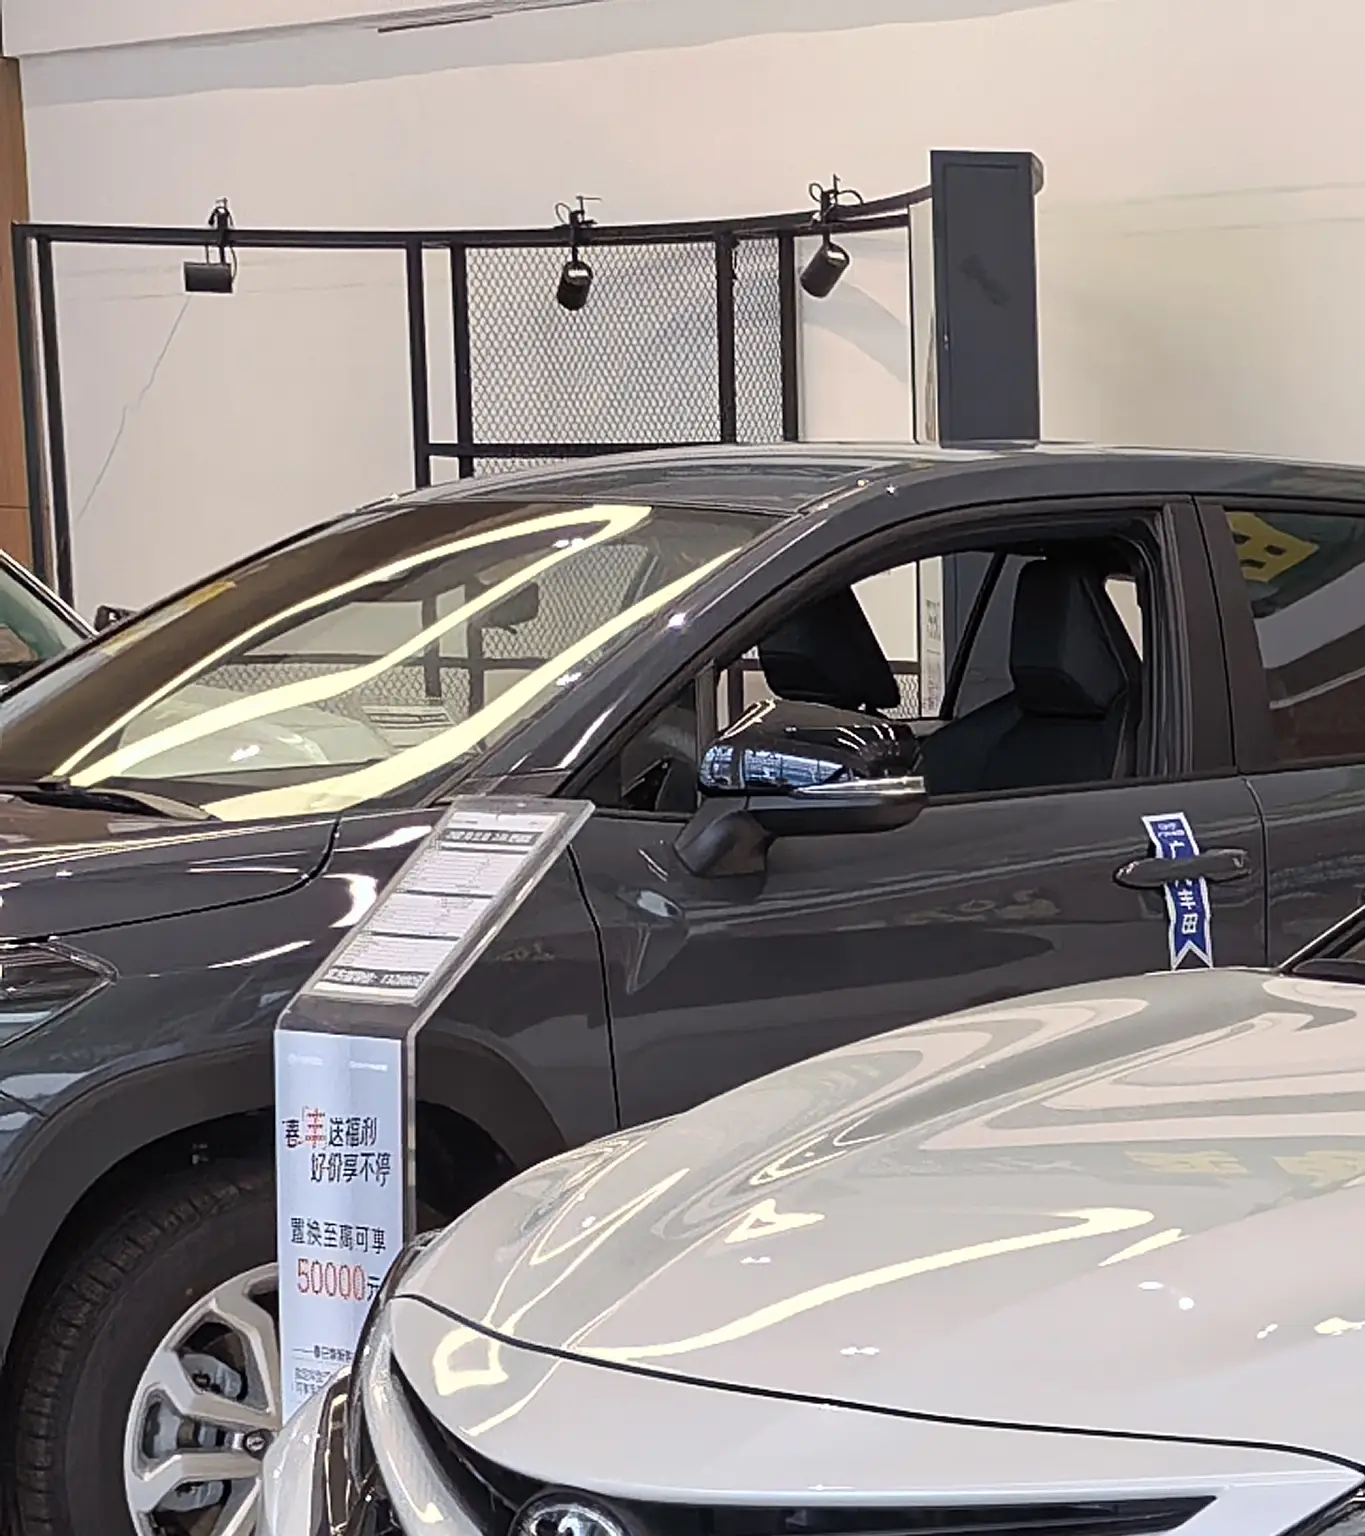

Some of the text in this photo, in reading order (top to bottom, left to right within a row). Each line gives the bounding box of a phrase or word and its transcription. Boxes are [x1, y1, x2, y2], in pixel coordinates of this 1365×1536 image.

[310, 1152, 392, 1187] 好价享不停
[290, 1217, 386, 1254] 置换至高可享
